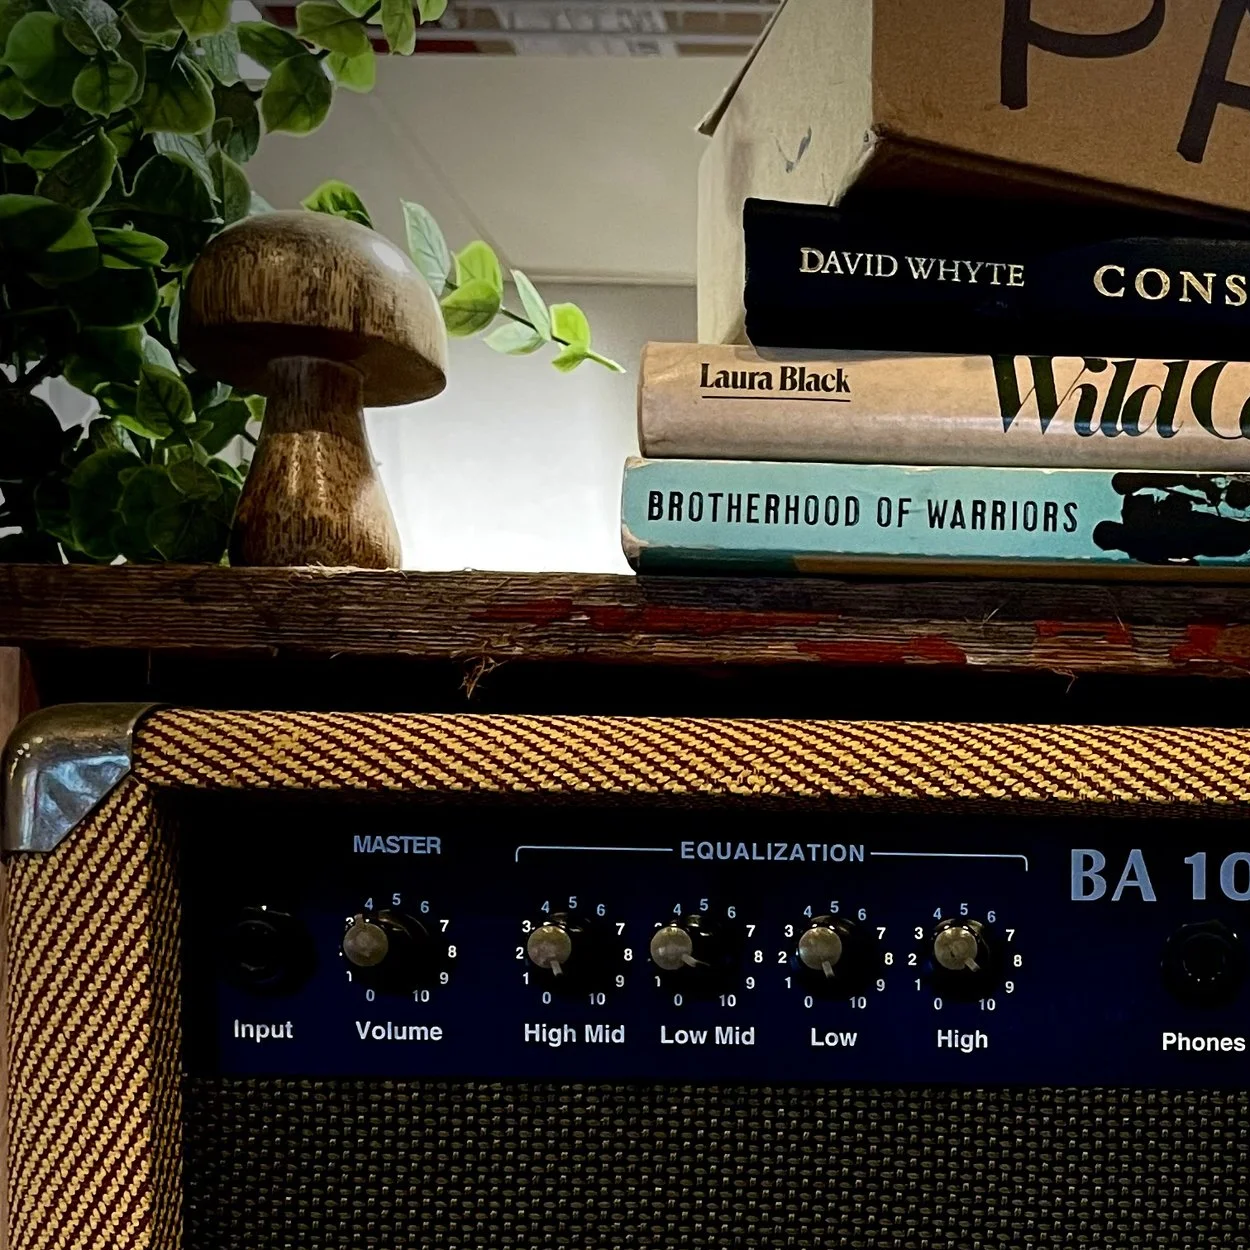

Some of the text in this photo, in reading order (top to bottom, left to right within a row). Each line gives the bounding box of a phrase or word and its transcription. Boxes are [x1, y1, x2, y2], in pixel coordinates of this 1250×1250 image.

[799, 247, 1025, 287] DAVID WHYTE
[700, 363, 851, 393] Laura Black
[647, 490, 1078, 533] BROTHERHOOD OF WARRIORS
[353, 835, 442, 855] MASTER
[680, 841, 865, 863] EQUALIZATION
[1070, 849, 1157, 902] BA
[364, 897, 373, 911] 4
[392, 893, 401, 906] 5
[568, 896, 577, 909] 5
[699, 898, 709, 911] 5
[420, 900, 430, 913] 6
[541, 900, 550, 913] 4
[596, 903, 606, 916] 6
[673, 903, 681, 916] 4
[727, 906, 736, 919] 6
[803, 905, 812, 918] 4
[830, 900, 839, 913] 5
[960, 903, 968, 916] 5
[857, 908, 867, 921] 6
[933, 907, 942, 920] 4
[987, 910, 996, 923] 6
[439, 919, 449, 932] 7
[522, 920, 531, 933] 3
[615, 922, 625, 936] 7
[745, 924, 756, 937] 7
[784, 924, 794, 937] 3
[876, 926, 886, 940] 7
[914, 926, 924, 940] 3
[1005, 928, 1015, 942] 7
[447, 945, 457, 958] 8
[515, 946, 524, 959] 2
[623, 948, 633, 961] 8
[754, 950, 763, 963] 8
[777, 951, 787, 964] 2
[884, 952, 894, 965] 8
[907, 953, 917, 966] 2
[1013, 954, 1023, 967] 8
[439, 972, 449, 985] 9
[522, 972, 529, 985] 1
[615, 975, 625, 987] 9
[745, 976, 755, 989] 9
[784, 976, 791, 989] 1
[876, 978, 886, 991] 9
[914, 978, 921, 991] 1
[1005, 980, 1014, 994] 9
[365, 989, 375, 1002] 0
[412, 989, 430, 1002] 10
[542, 991, 552, 1004] 0
[588, 992, 606, 1005] 10
[673, 993, 683, 1006] 0
[719, 994, 736, 1007] 10
[804, 995, 813, 1008] 0
[849, 996, 867, 1009] 10
[933, 997, 943, 1010] 0
[979, 998, 996, 1011] 10
[233, 1019, 294, 1042] Input
[355, 1021, 443, 1041] Volume
[523, 1023, 625, 1047] High Mid
[660, 1025, 756, 1046] Low Mid
[811, 1028, 858, 1047] Low
[937, 1030, 988, 1053] High
[1162, 1032, 1246, 1053] Phones
